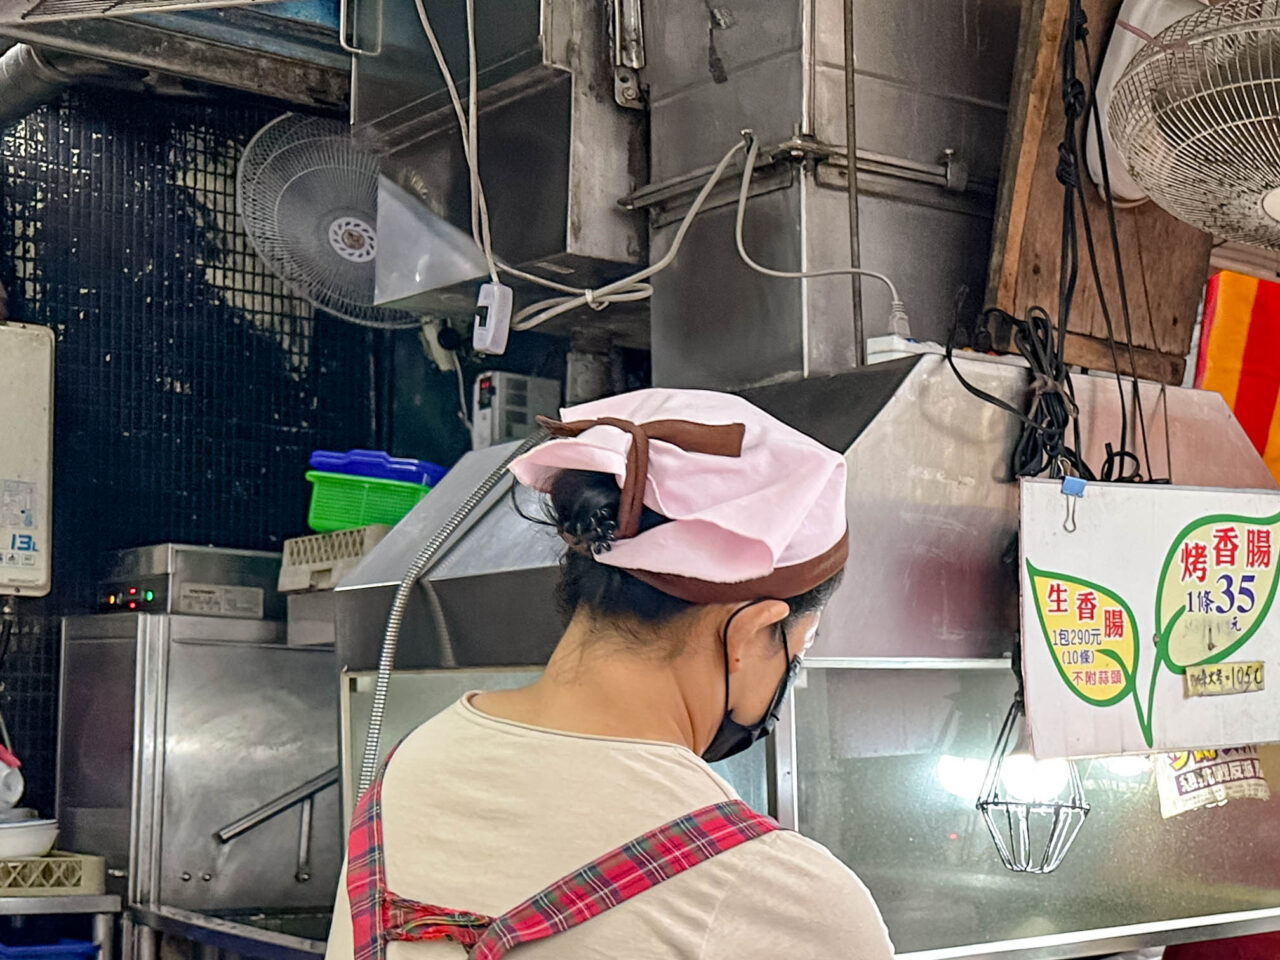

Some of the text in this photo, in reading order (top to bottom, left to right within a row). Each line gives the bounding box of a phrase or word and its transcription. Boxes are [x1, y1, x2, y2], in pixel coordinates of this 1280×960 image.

[1180, 526, 1271, 583] 烤香腸
[1047, 583, 1124, 638] 生香腸
[1052, 628, 1102, 646] 1包290元
[1062, 649, 1095, 664] (10條)
[1072, 670, 1122, 686] 不附蒜頭
